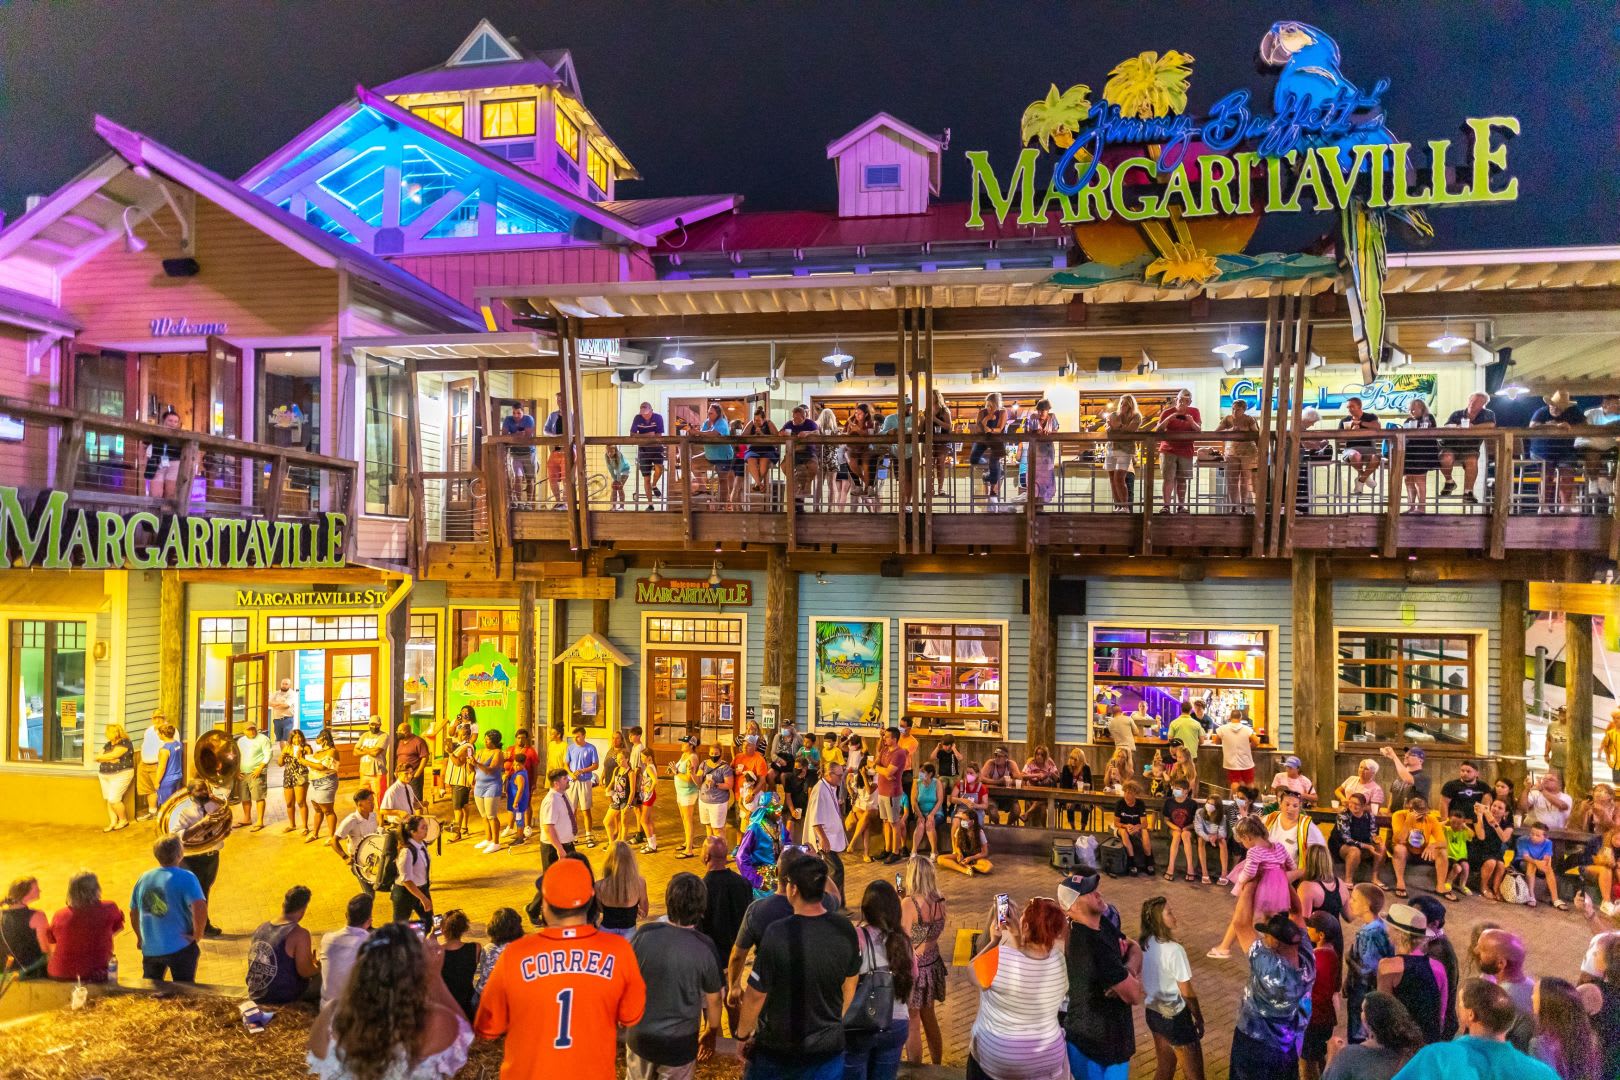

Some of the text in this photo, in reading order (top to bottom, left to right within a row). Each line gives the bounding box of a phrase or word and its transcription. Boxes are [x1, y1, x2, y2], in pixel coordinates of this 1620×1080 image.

[1053, 98, 1201, 197] Jimmy
[965, 116, 1521, 228] MARGARITAVILLE
[150, 316, 229, 336] Welcome
[0, 485, 347, 569] MARGARITAVILLE
[236, 590, 362, 606] MARGARITAVILLE
[637, 582, 748, 604] MARGARITAVILLE
[469, 699, 502, 708] DESTIN
[520, 949, 616, 982] CORREA
[554, 987, 574, 1049] 1
